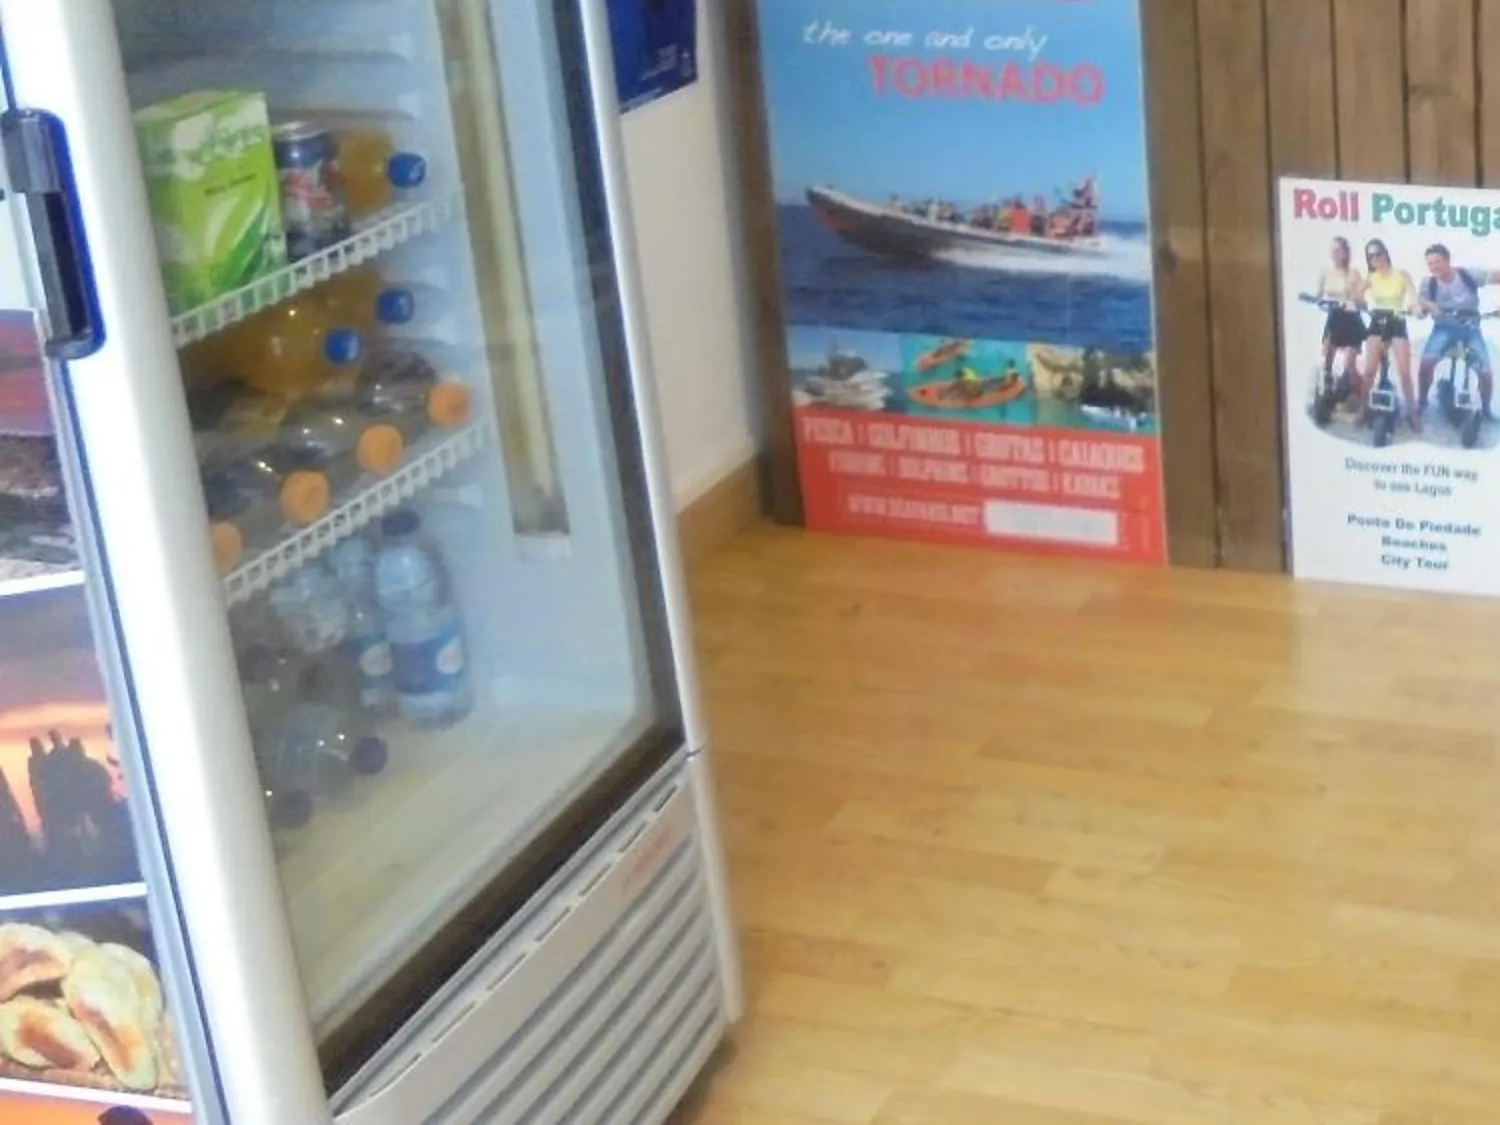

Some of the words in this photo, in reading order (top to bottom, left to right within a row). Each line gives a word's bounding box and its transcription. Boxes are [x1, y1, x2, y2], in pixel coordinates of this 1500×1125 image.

[803, 19, 851, 47] the
[864, 30, 914, 48] one
[924, 26, 975, 50] and
[983, 24, 1049, 61] only
[867, 54, 1107, 106] TORNADO
[1293, 188, 1359, 222] Roll
[1345, 457, 1397, 475] Discover
[1401, 463, 1420, 475] the
[1423, 464, 1450, 478] FUN
[1454, 470, 1478, 482] way
[1374, 480, 1386, 490] to
[1415, 482, 1452, 498] Lagos
[1419, 520, 1481, 536] Piedade
[1381, 535, 1447, 551] Beaches
[1381, 554, 1411, 570] City
[1416, 557, 1449, 571] Tour
